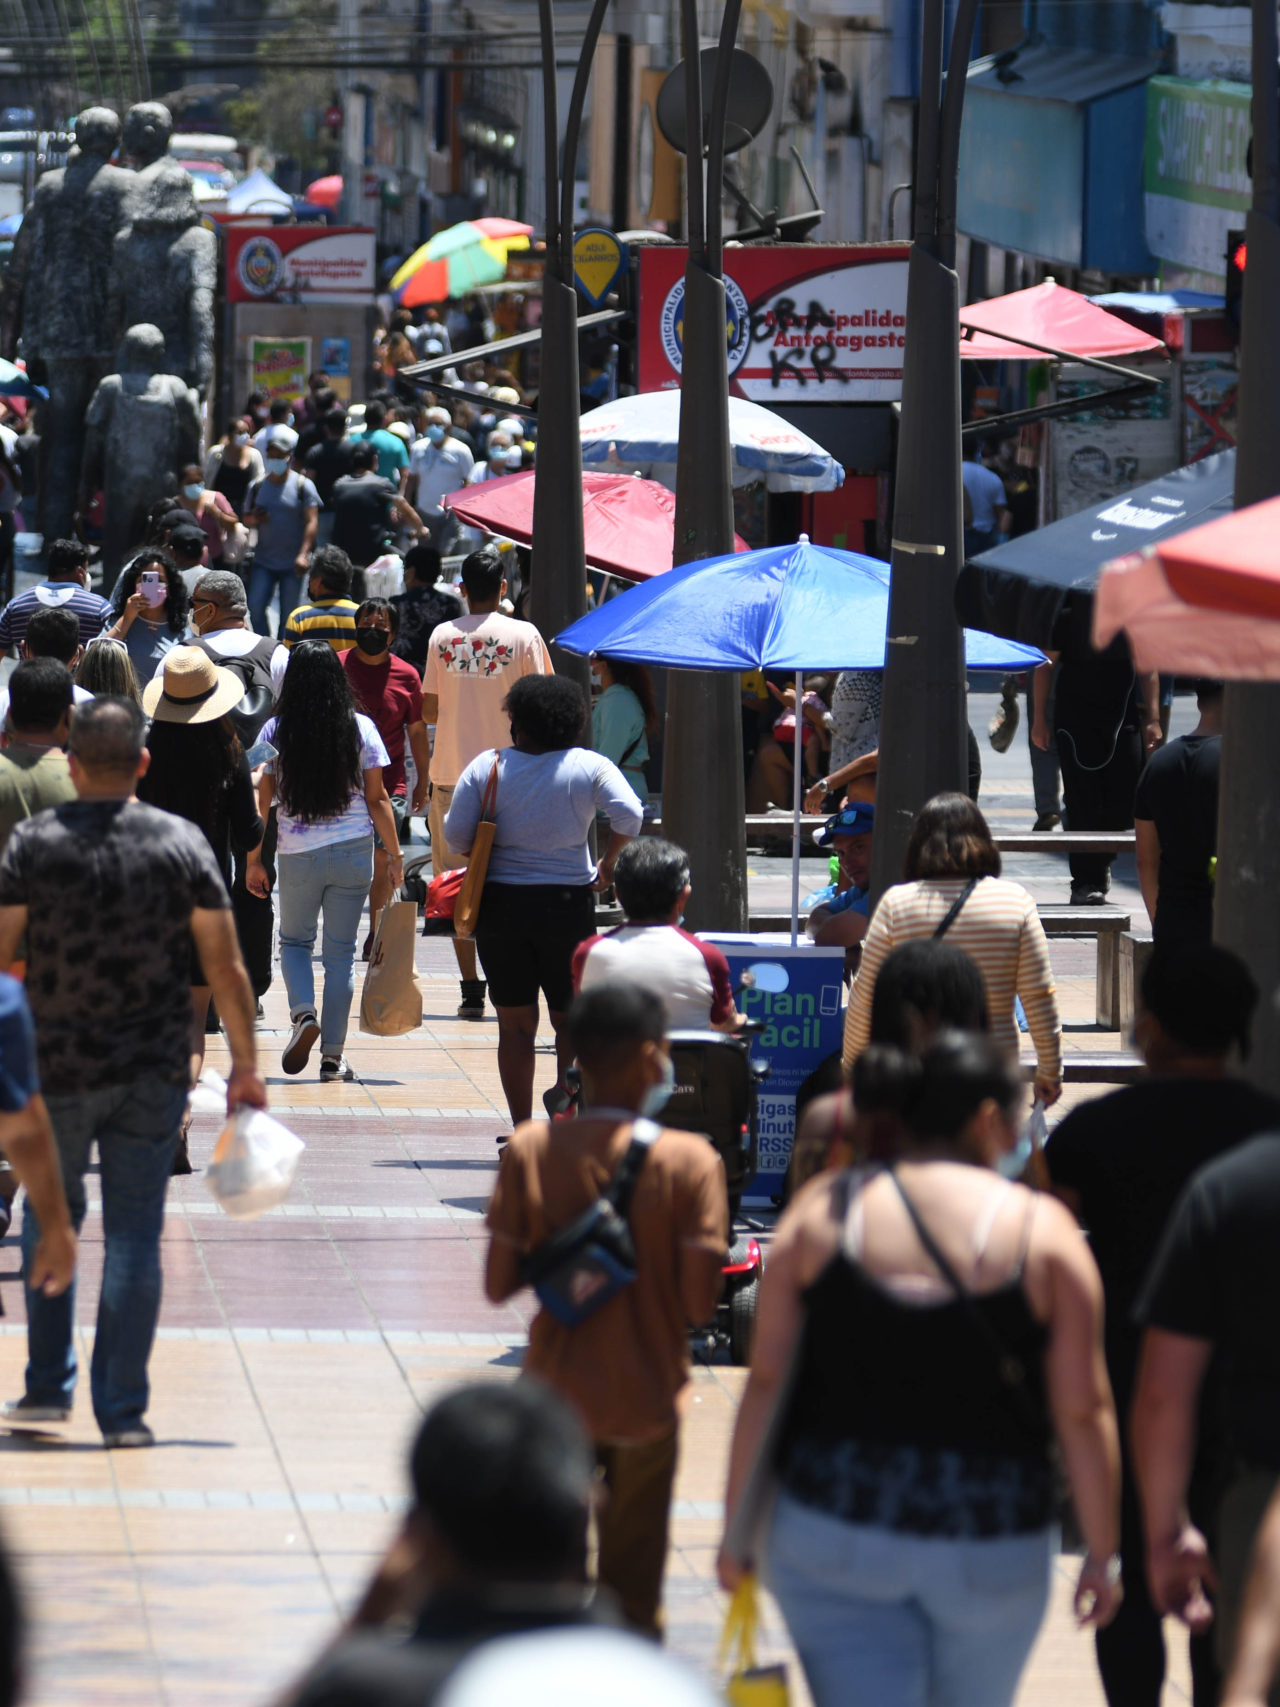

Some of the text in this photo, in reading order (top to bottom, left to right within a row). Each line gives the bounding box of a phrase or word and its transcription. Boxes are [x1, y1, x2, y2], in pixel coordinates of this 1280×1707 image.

[663, 281, 686, 365] MUNICIPALIDA
[765, 309, 905, 331] Munipalida
[741, 986, 815, 1017] Plan
[748, 1017, 821, 1049] ácil
[756, 1099, 797, 1118] igas
[756, 1118, 794, 1134] inut
[759, 1137, 793, 1153] RSS
